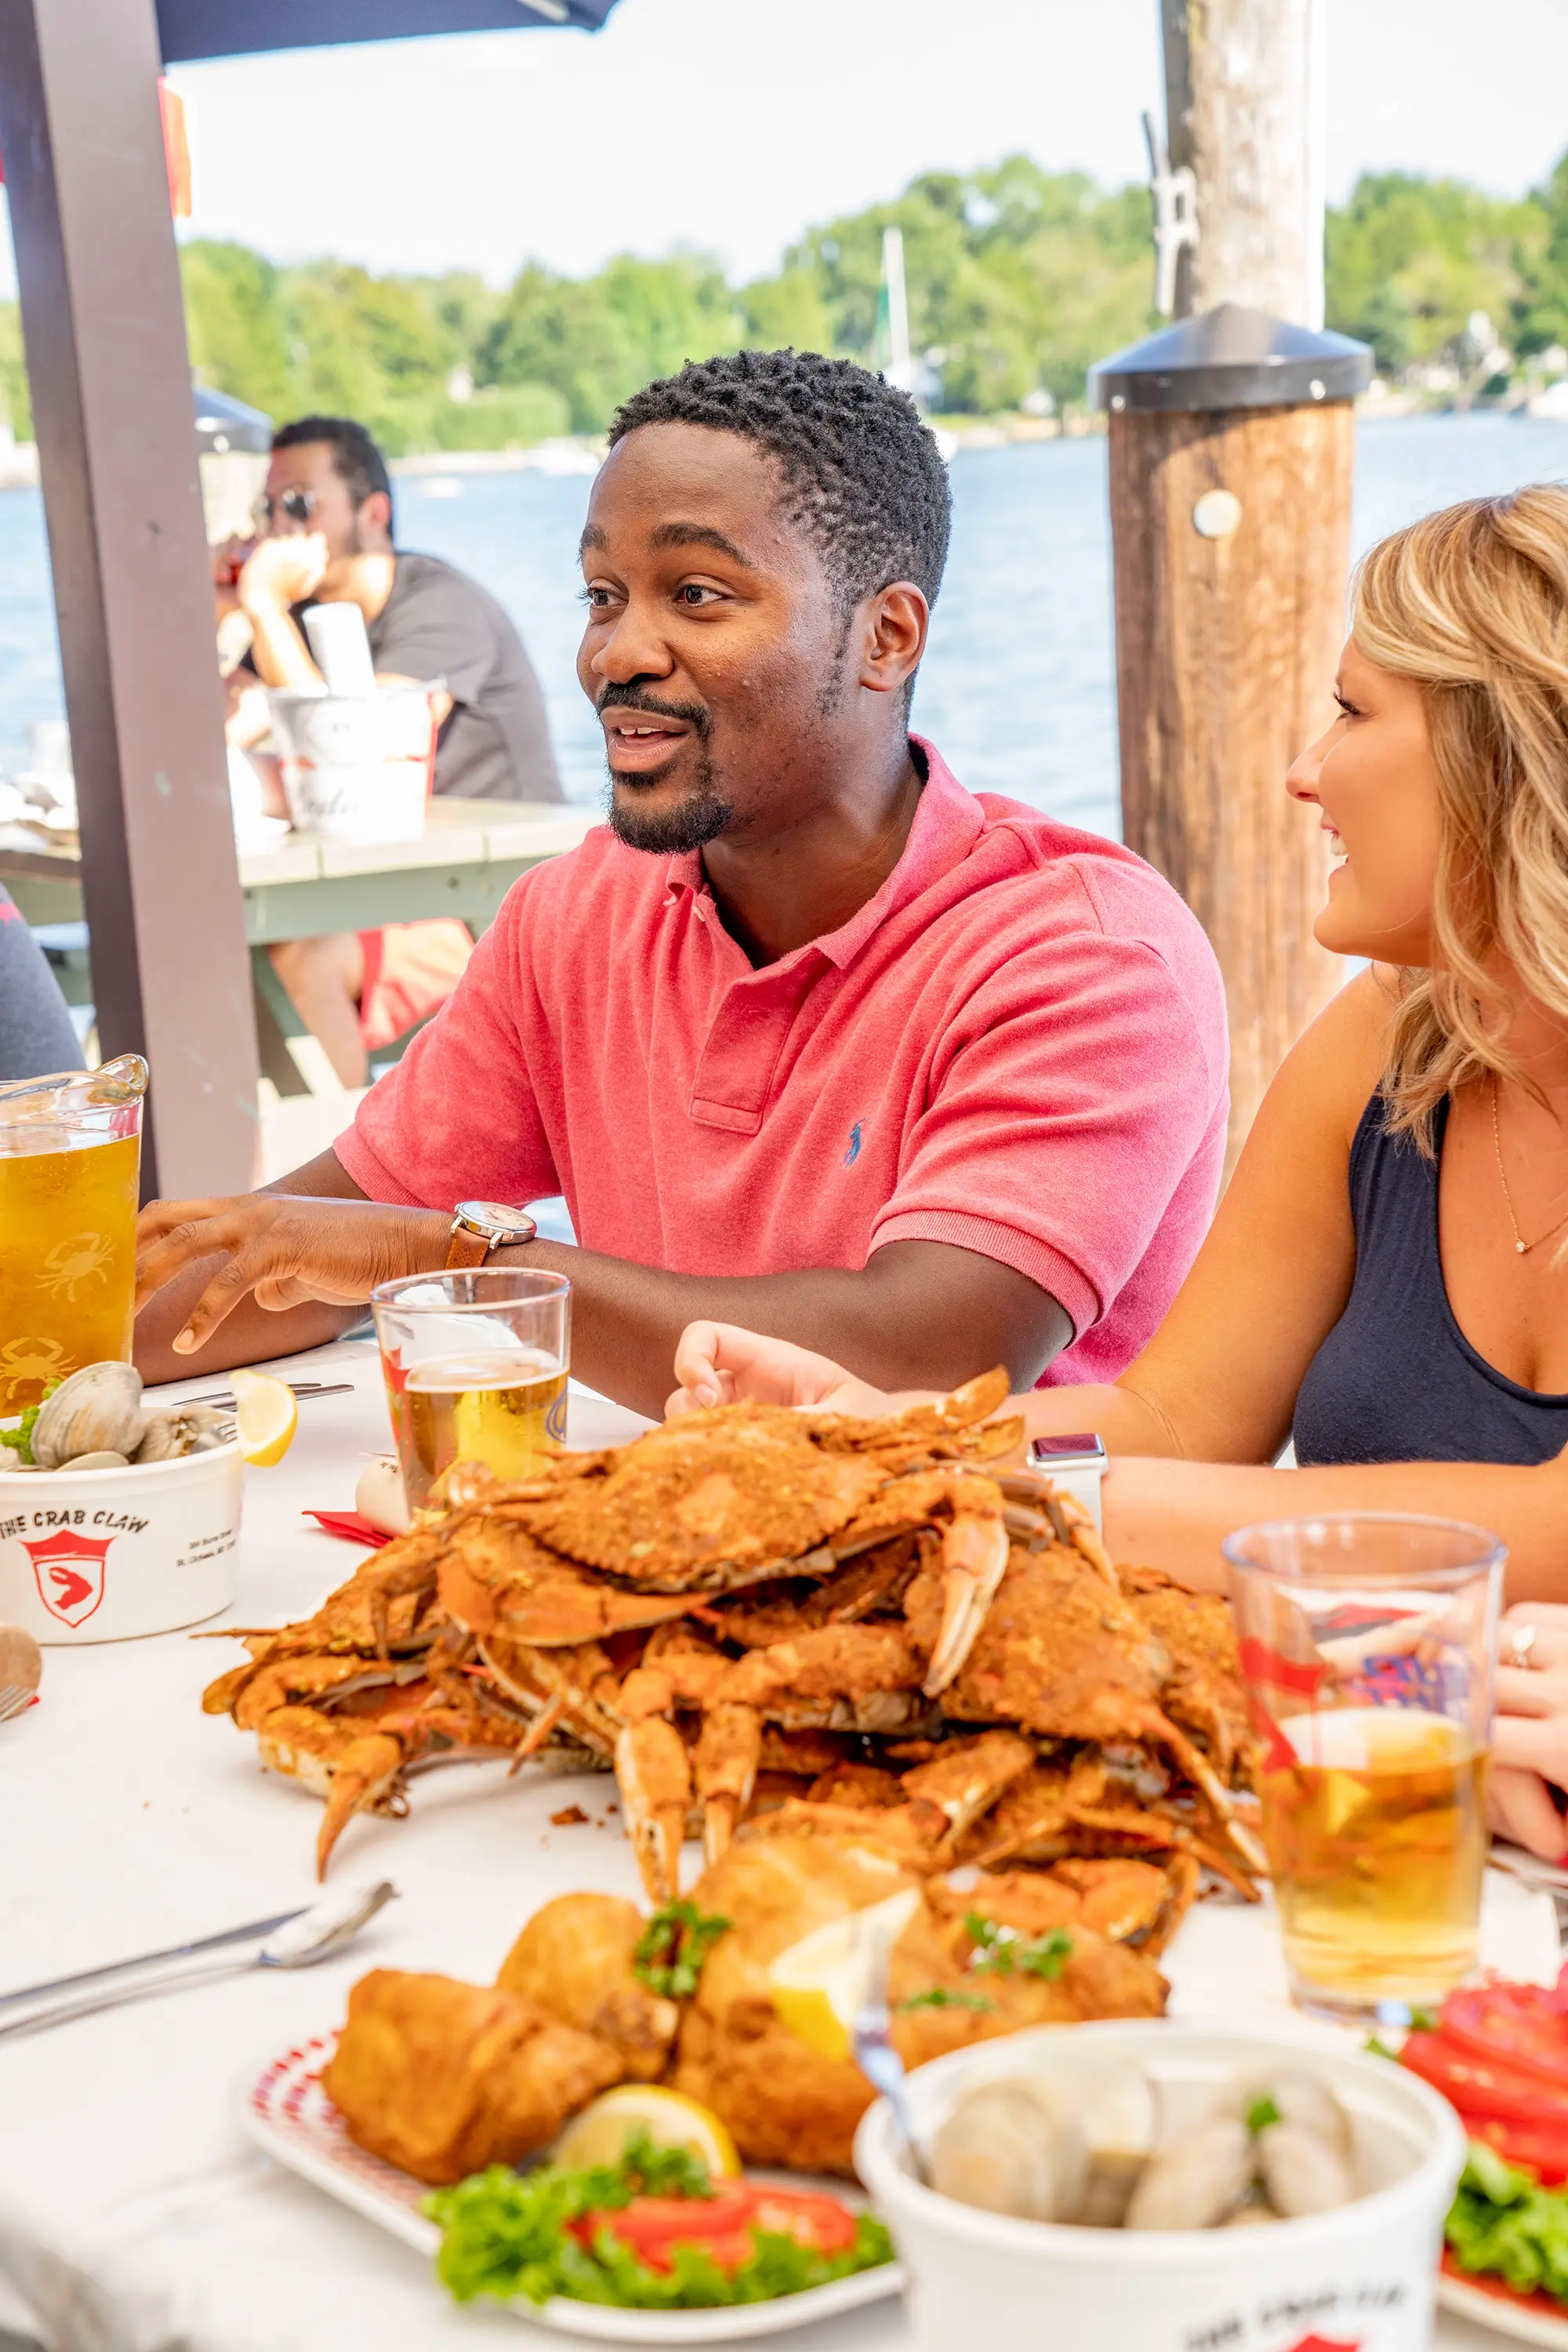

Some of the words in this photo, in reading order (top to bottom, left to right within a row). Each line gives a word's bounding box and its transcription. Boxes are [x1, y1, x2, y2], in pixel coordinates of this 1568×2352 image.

[0, 1514, 27, 1540] THE
[34, 1510, 85, 1526] CRAB
[93, 1510, 150, 1534] CLAW
